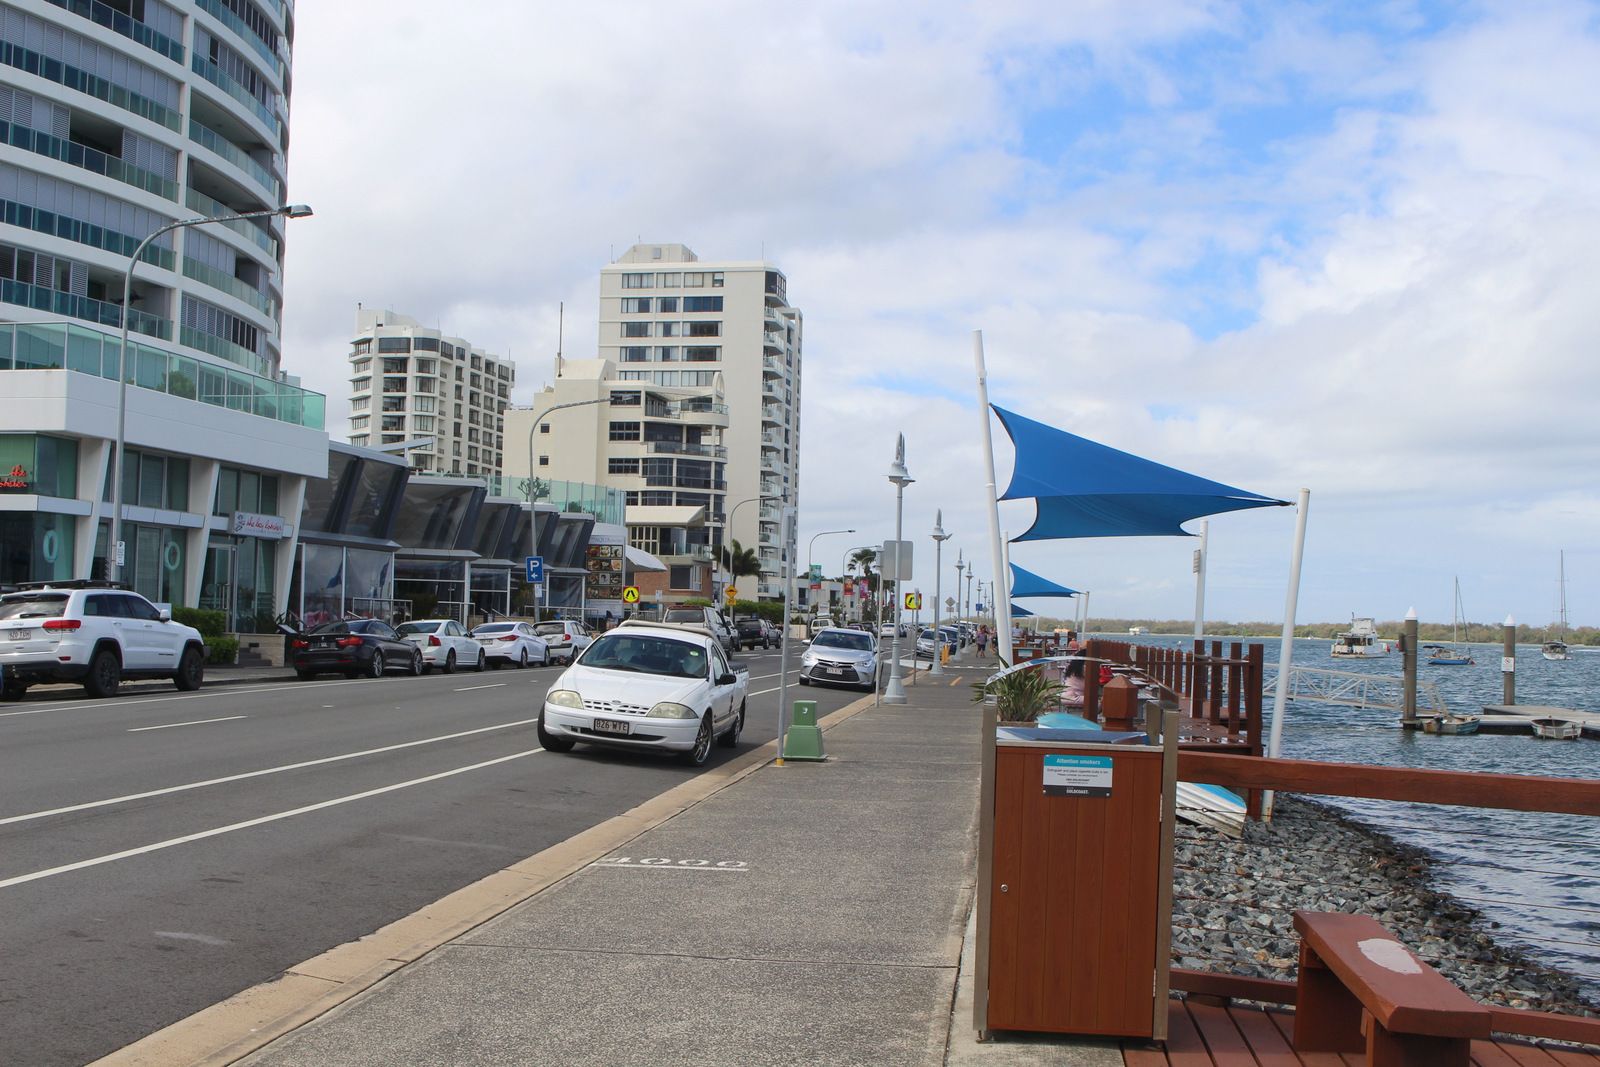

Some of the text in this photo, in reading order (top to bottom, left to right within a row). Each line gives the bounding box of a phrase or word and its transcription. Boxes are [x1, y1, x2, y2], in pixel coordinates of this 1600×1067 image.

[530, 560, 540, 572] P
[596, 720, 627, 731] 826 WTE
